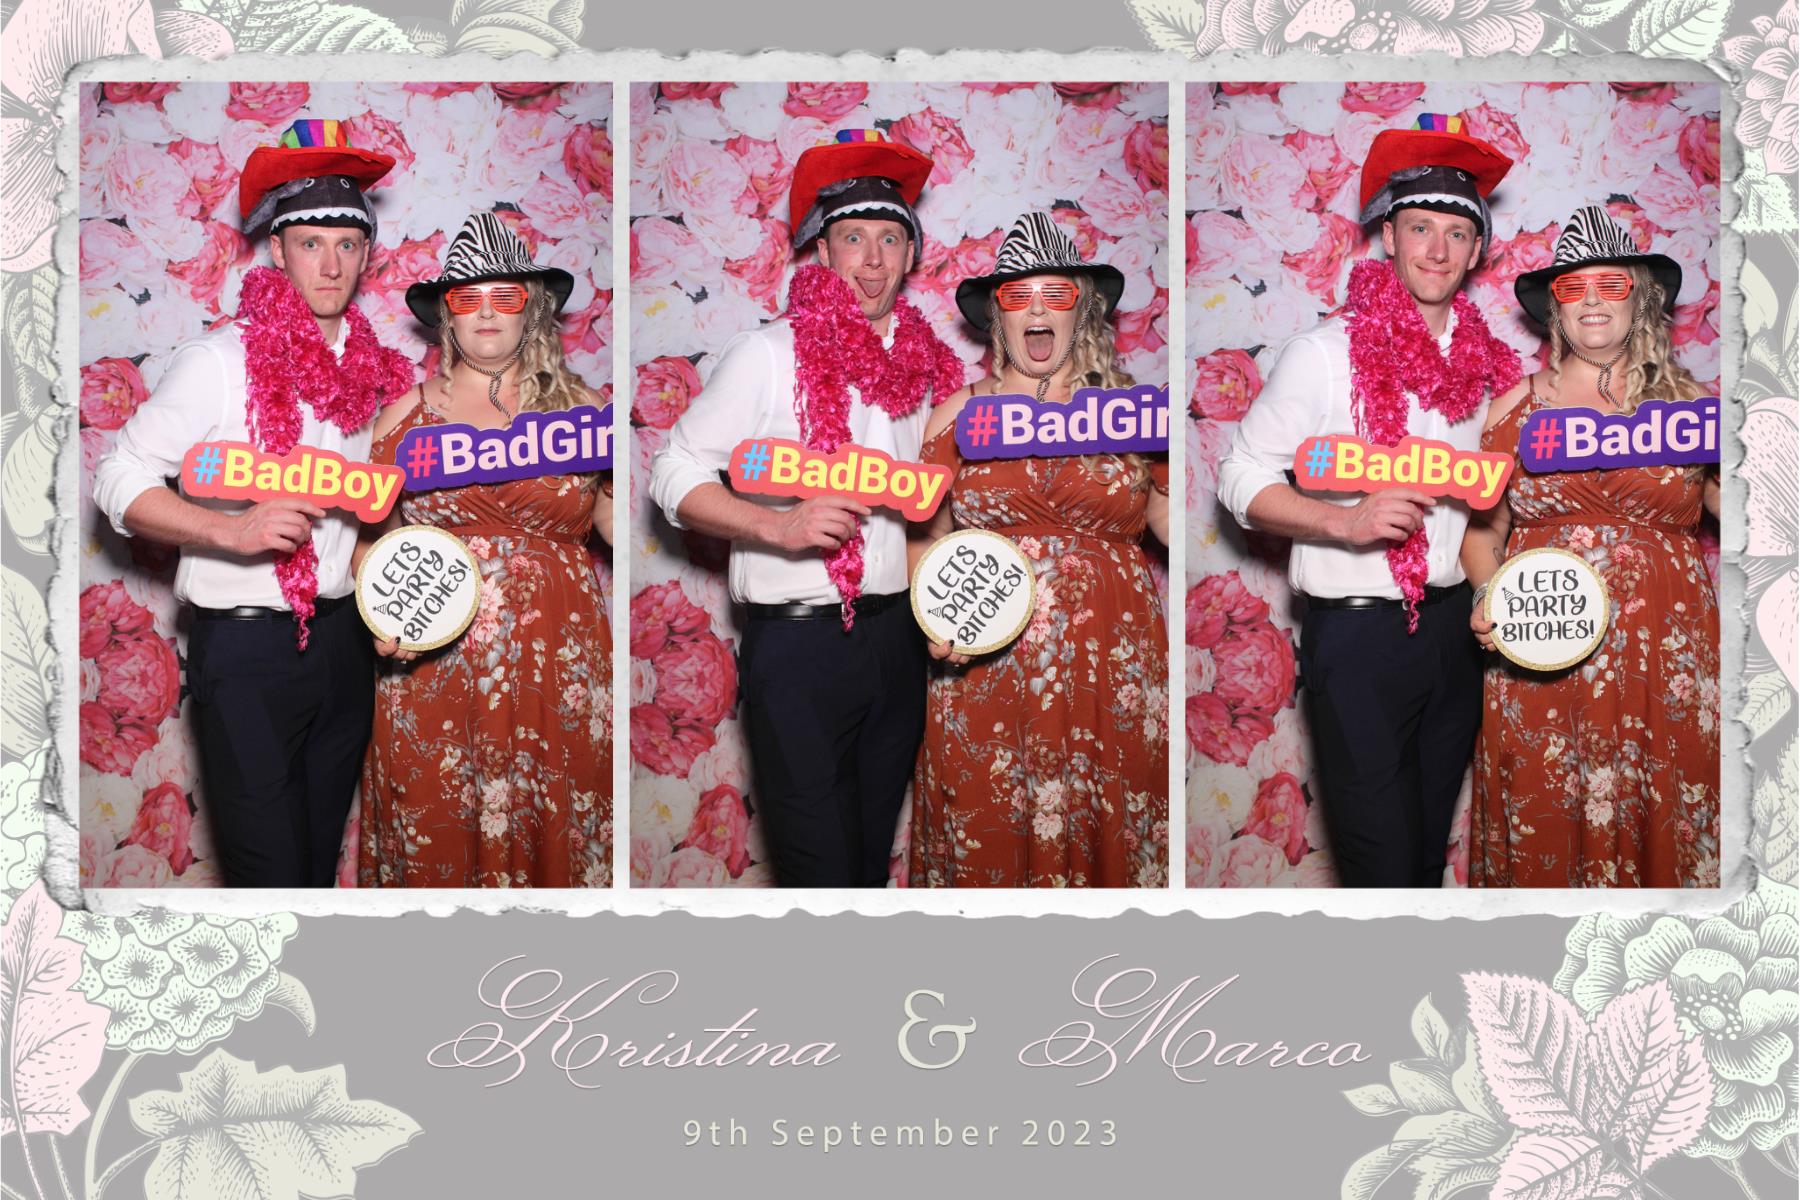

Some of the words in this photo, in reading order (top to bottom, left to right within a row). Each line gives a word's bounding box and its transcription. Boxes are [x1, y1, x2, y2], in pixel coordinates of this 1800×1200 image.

[193, 446, 397, 511] #BadBoy
[740, 443, 944, 510] #BadBoy
[1305, 440, 1508, 498] #BadBoy
[372, 540, 422, 598] LETS
[386, 550, 444, 622] PARTY
[927, 544, 977, 601] LETS
[941, 553, 1000, 626] PARTY
[1518, 569, 1579, 593] LETS
[403, 559, 473, 642] BITCHES!
[957, 563, 1028, 646] BITCHES!
[1508, 595, 1587, 618] PARTY
[1501, 621, 1595, 643] BITCHES!
